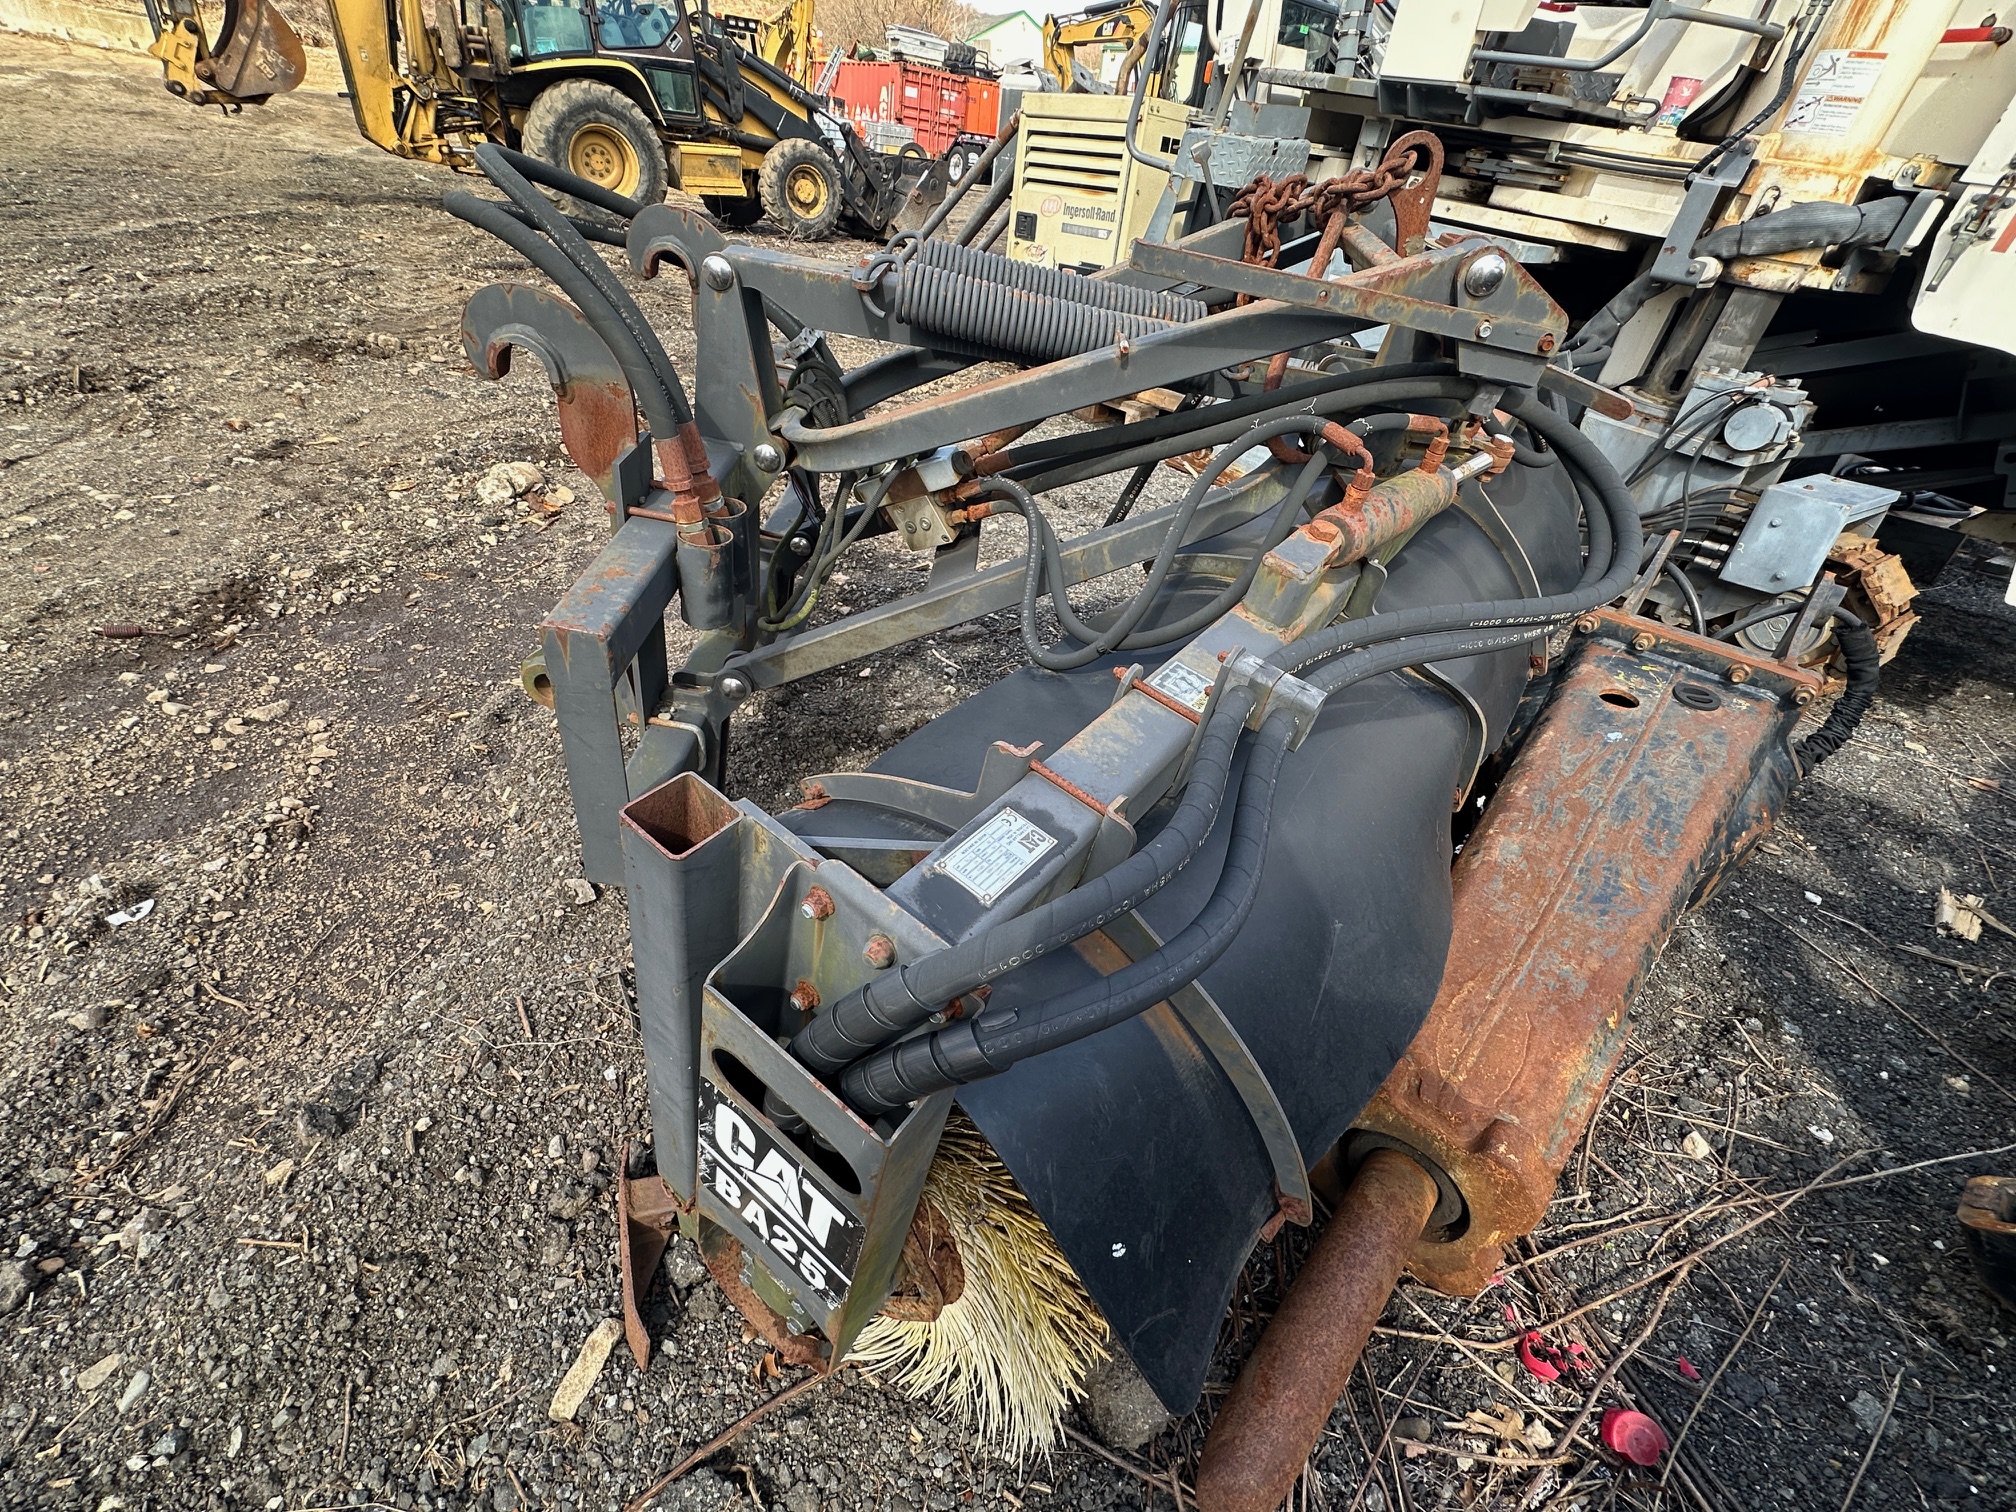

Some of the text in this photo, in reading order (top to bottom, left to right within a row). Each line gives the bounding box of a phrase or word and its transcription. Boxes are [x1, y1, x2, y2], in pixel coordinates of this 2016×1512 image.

[1017, 829, 1047, 854] CAT
[715, 1103, 846, 1249] CAT
[715, 1164, 826, 1290] BA25
